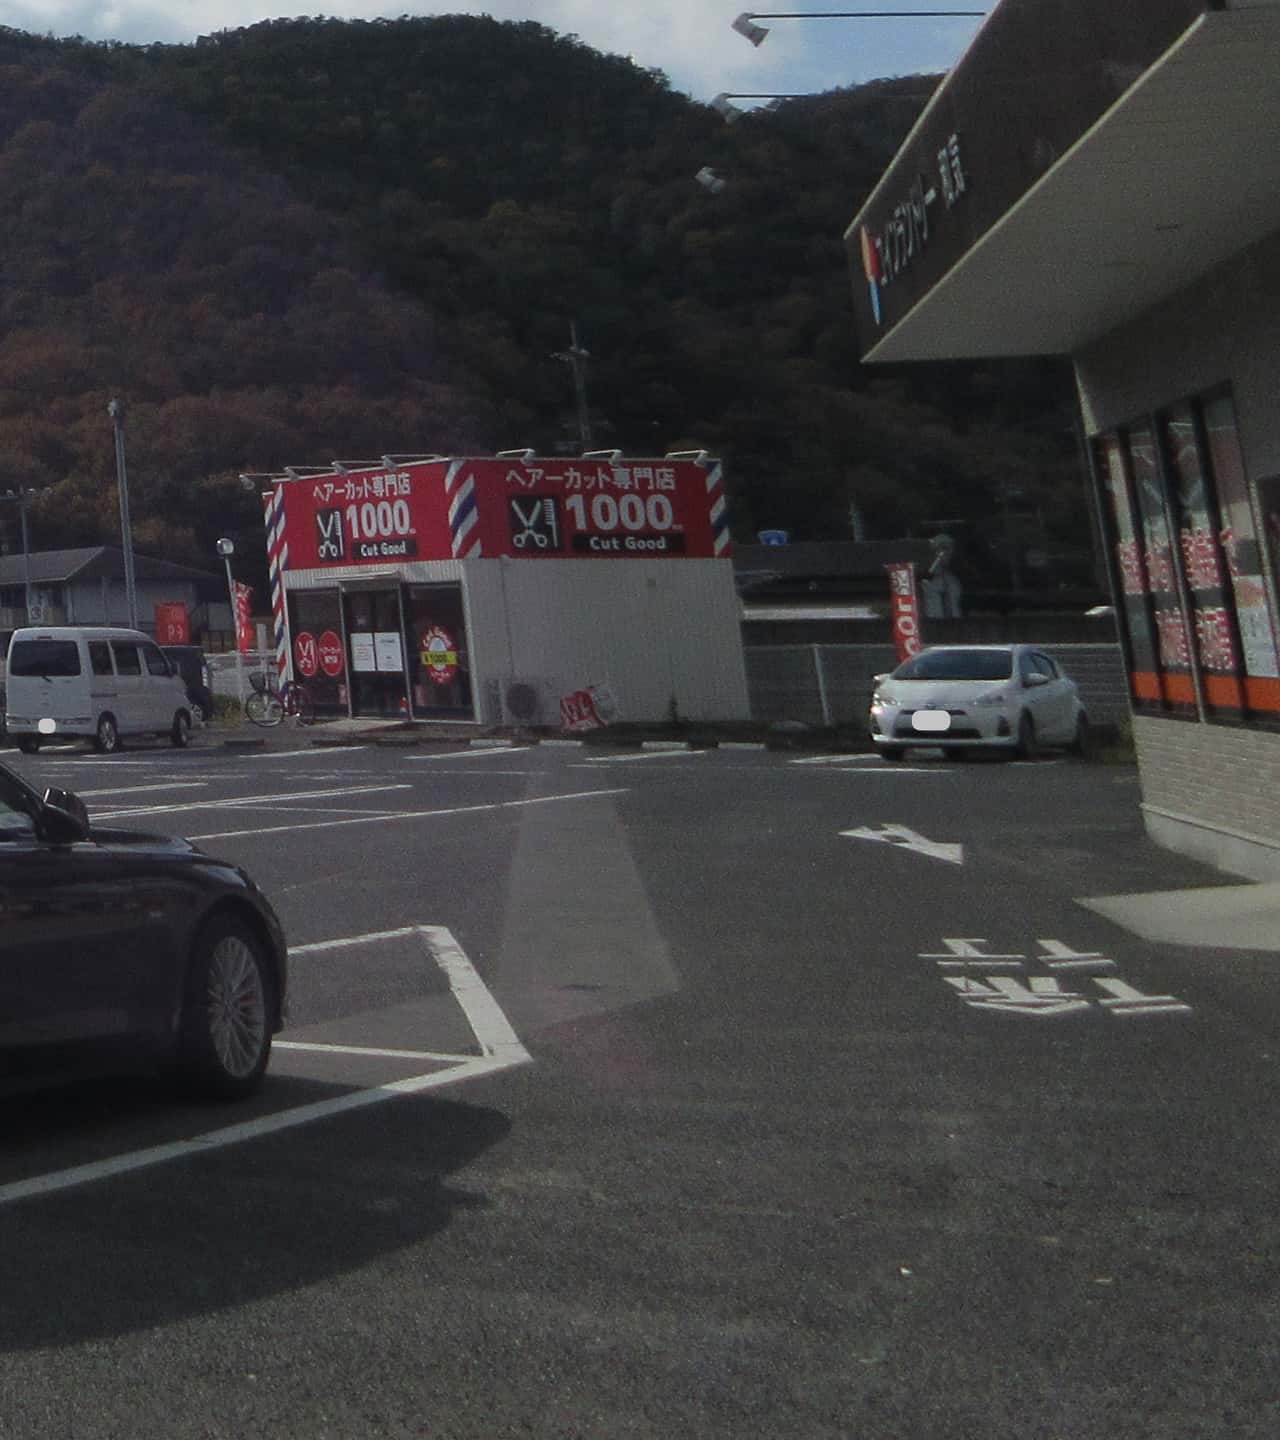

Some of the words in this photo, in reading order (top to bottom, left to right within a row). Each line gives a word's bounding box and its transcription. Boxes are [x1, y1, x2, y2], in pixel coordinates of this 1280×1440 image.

[313, 471, 411, 502] ヘアーカット専門店
[506, 467, 676, 490] ヘアーカット専門店
[347, 499, 410, 539] 1000
[565, 493, 673, 531] 1000
[360, 543, 379, 557] Cut
[381, 540, 407, 555] Good
[590, 536, 620, 550] Cut
[625, 536, 667, 550] Good
